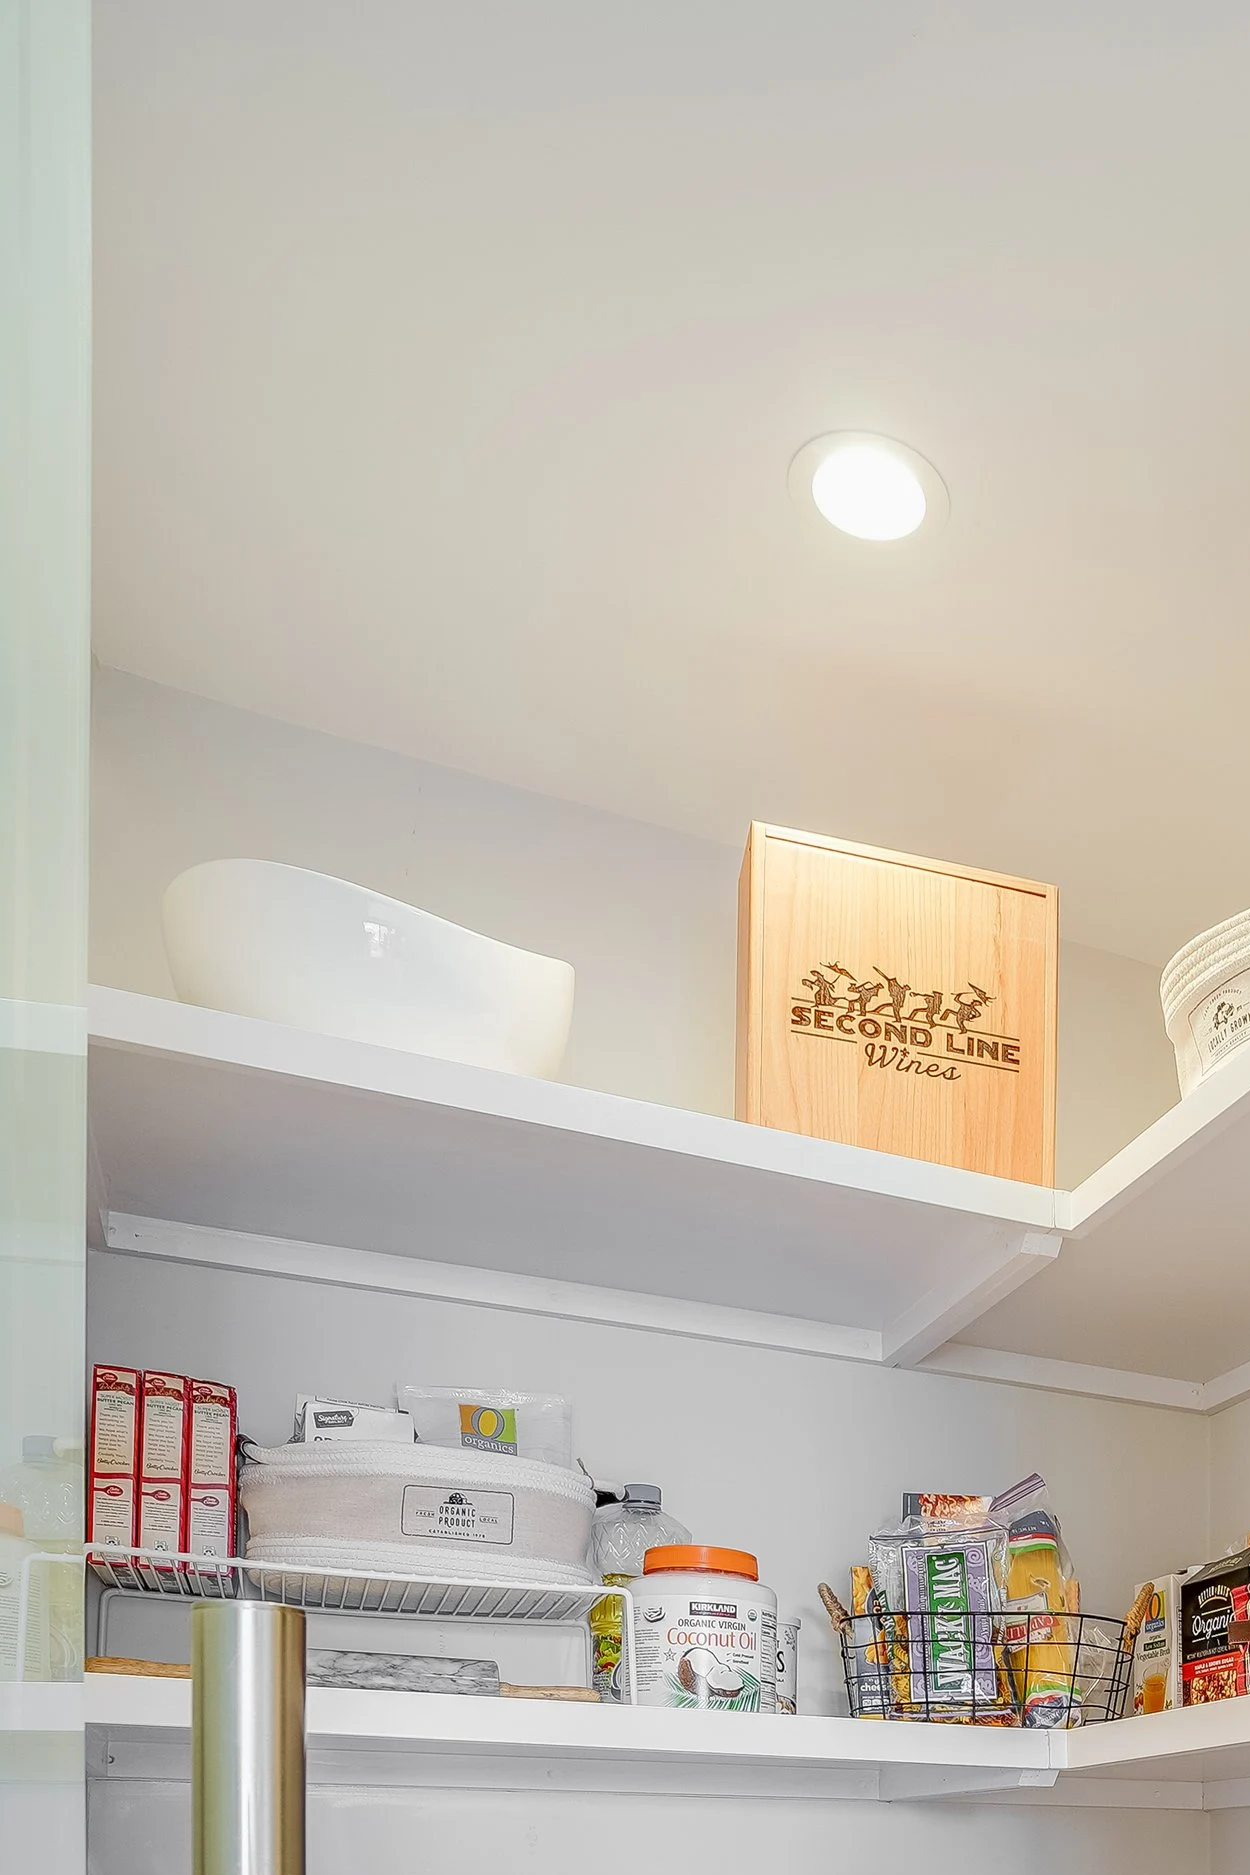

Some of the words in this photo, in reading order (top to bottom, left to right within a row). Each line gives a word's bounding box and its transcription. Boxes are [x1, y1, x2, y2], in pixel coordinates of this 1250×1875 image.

[790, 1006, 933, 1049] SECOND
[946, 1033, 1020, 1066] LINE
[864, 1042, 962, 1081] Wines
[464, 1435, 515, 1454] organics
[439, 1505, 476, 1518] ORGANIC
[438, 1516, 475, 1529] PRODUCT
[932, 1556, 962, 1600] MAC
[691, 1603, 737, 1614] KIRKLAND
[677, 1618, 716, 1629] ORGANIC
[718, 1620, 747, 1631] VIRGIN
[667, 1627, 736, 1648] Coconut
[739, 1631, 757, 1651] Oil
